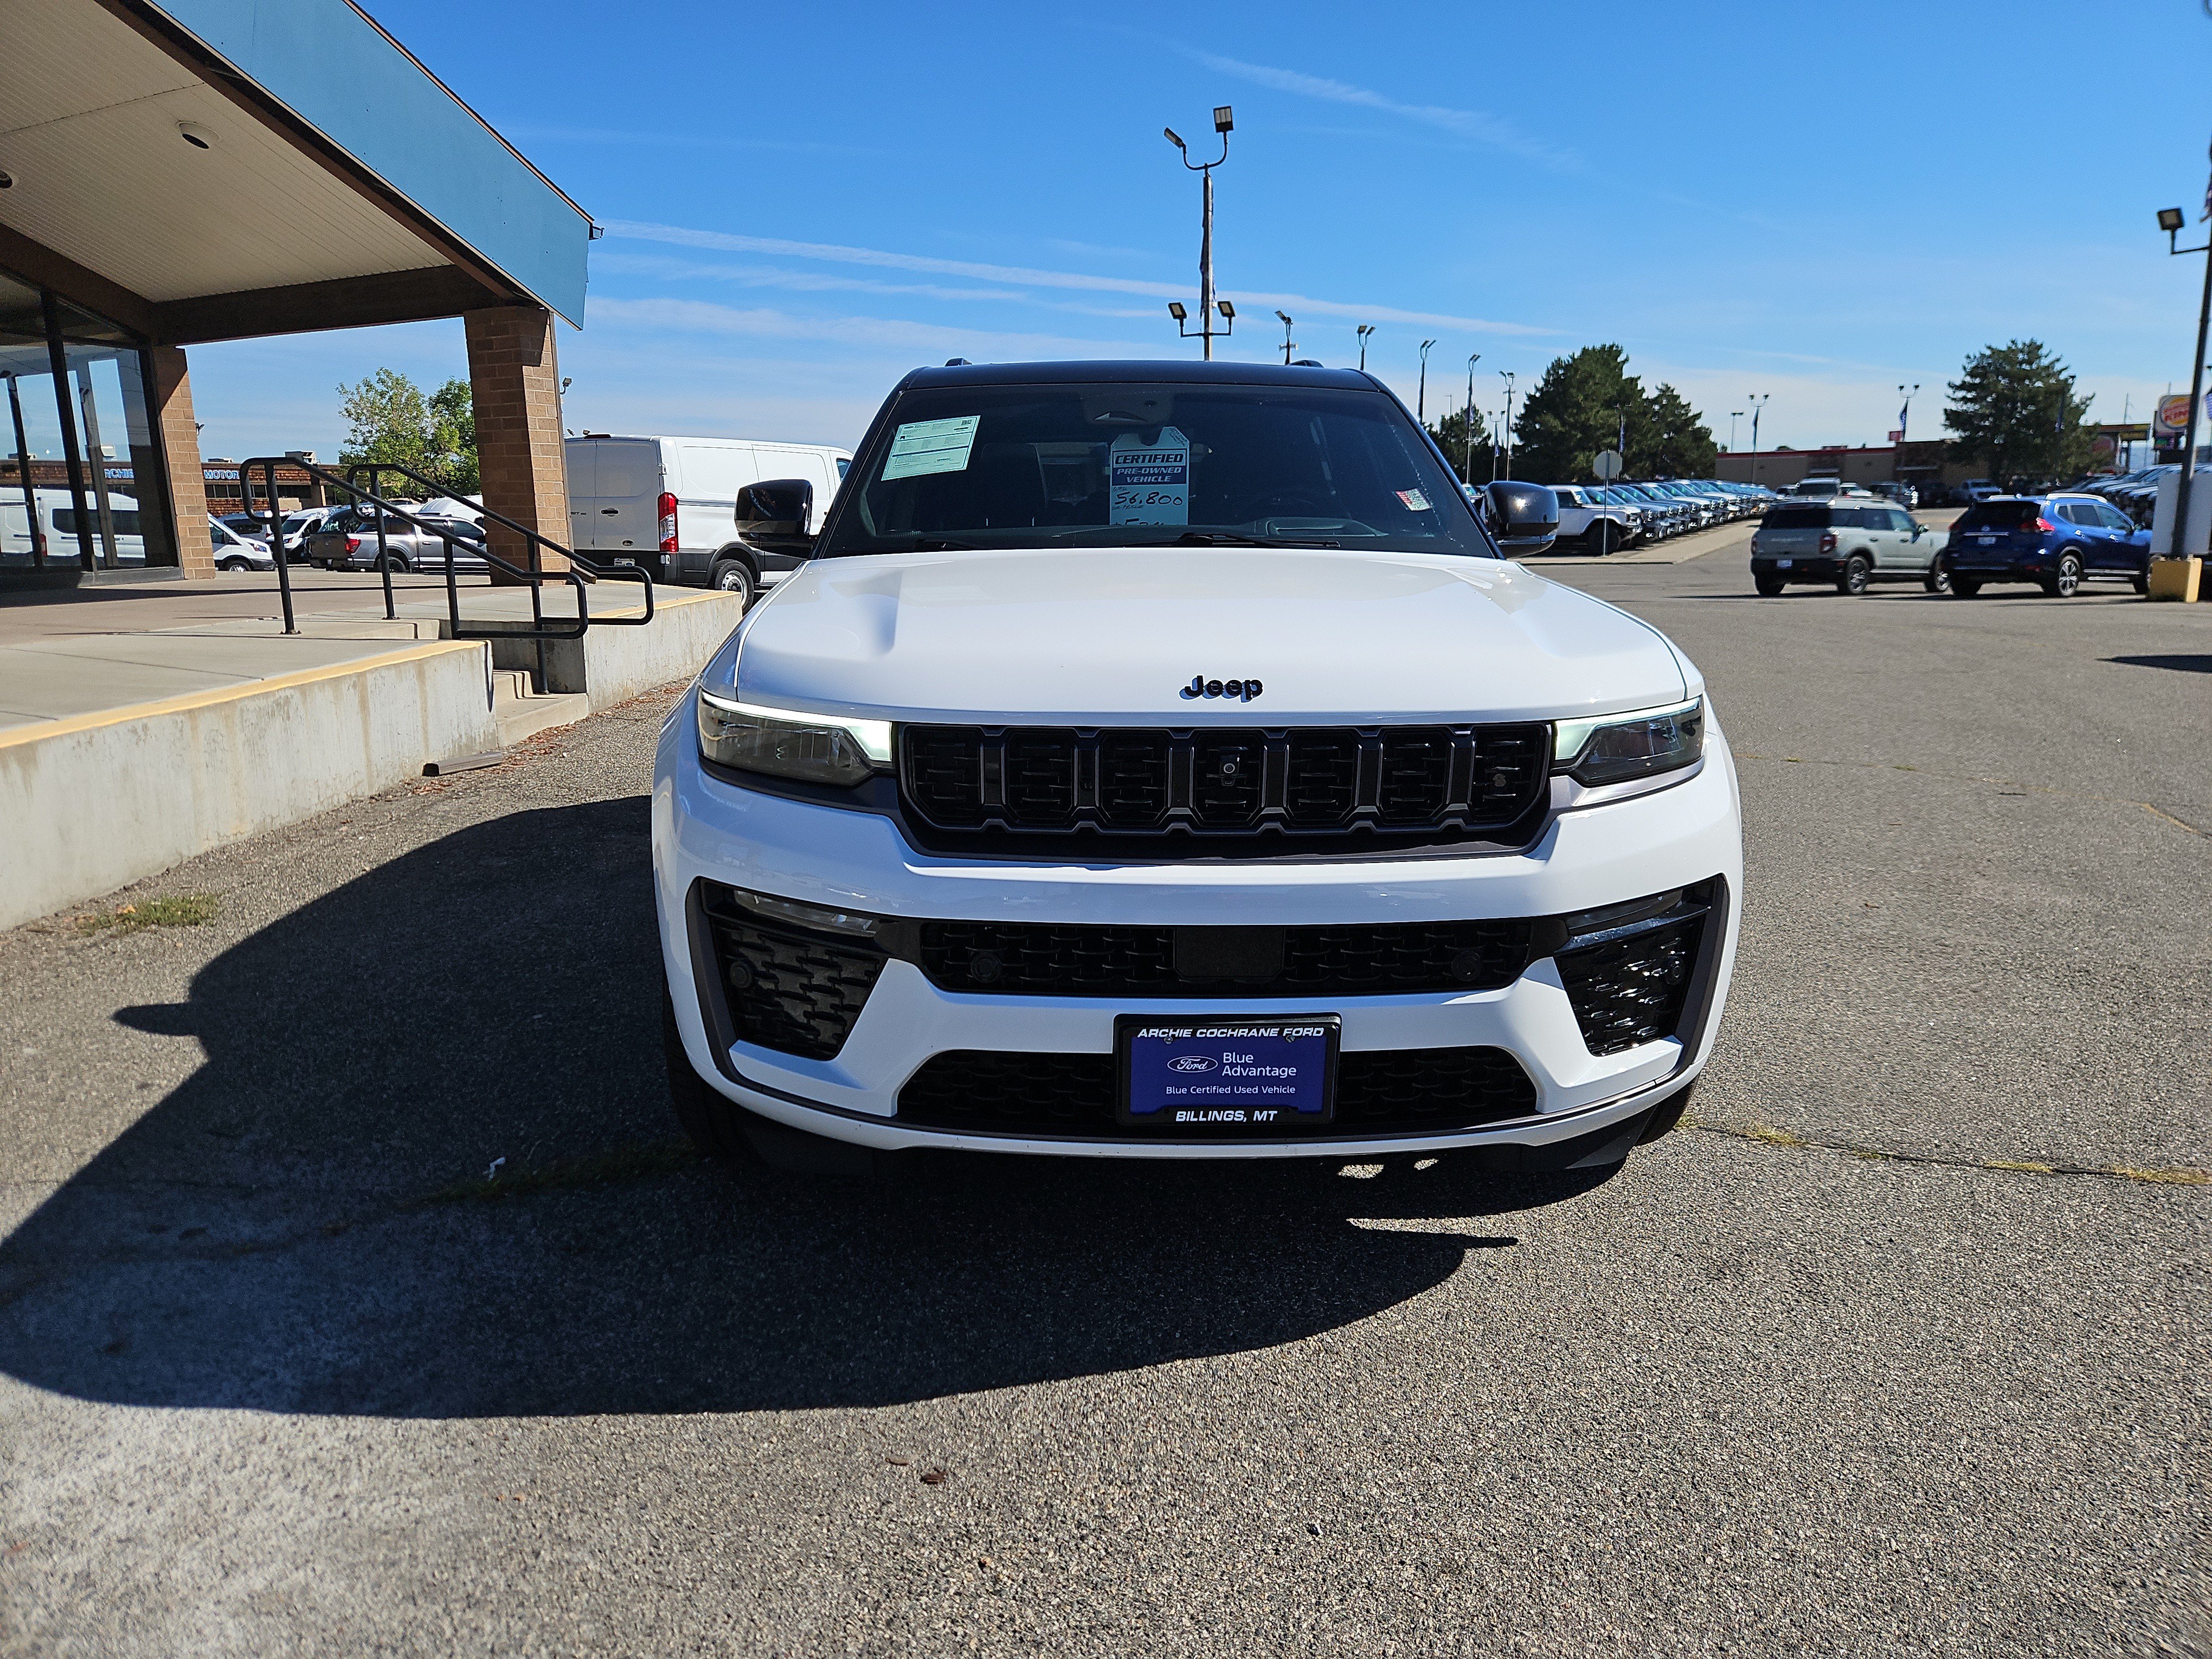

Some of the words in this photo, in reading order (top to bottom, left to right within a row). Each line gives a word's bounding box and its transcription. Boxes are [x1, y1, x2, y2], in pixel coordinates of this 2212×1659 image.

[1115, 453, 1184, 465] CERTIFIED
[104, 468, 134, 479] RCHIE
[1116, 467, 1182, 475] PRE-OWNED
[1179, 675, 1263, 703] Jeep
[1137, 1028, 1193, 1038] ARCHIE
[1196, 1027, 1280, 1038] COCHRANE
[1282, 1027, 1324, 1037] FORD
[1223, 1051, 1254, 1063] Blue
[1176, 1058, 1208, 1070] Ford
[1221, 1064, 1297, 1078] Advantage
[1166, 1086, 1187, 1094] Blue
[1190, 1085, 1231, 1094] Certified
[1234, 1085, 1258, 1094] Used
[1261, 1085, 1296, 1094] Vehicle
[1175, 1110, 1247, 1122] BILLINGS,
[1253, 1110, 1278, 1121] MT
